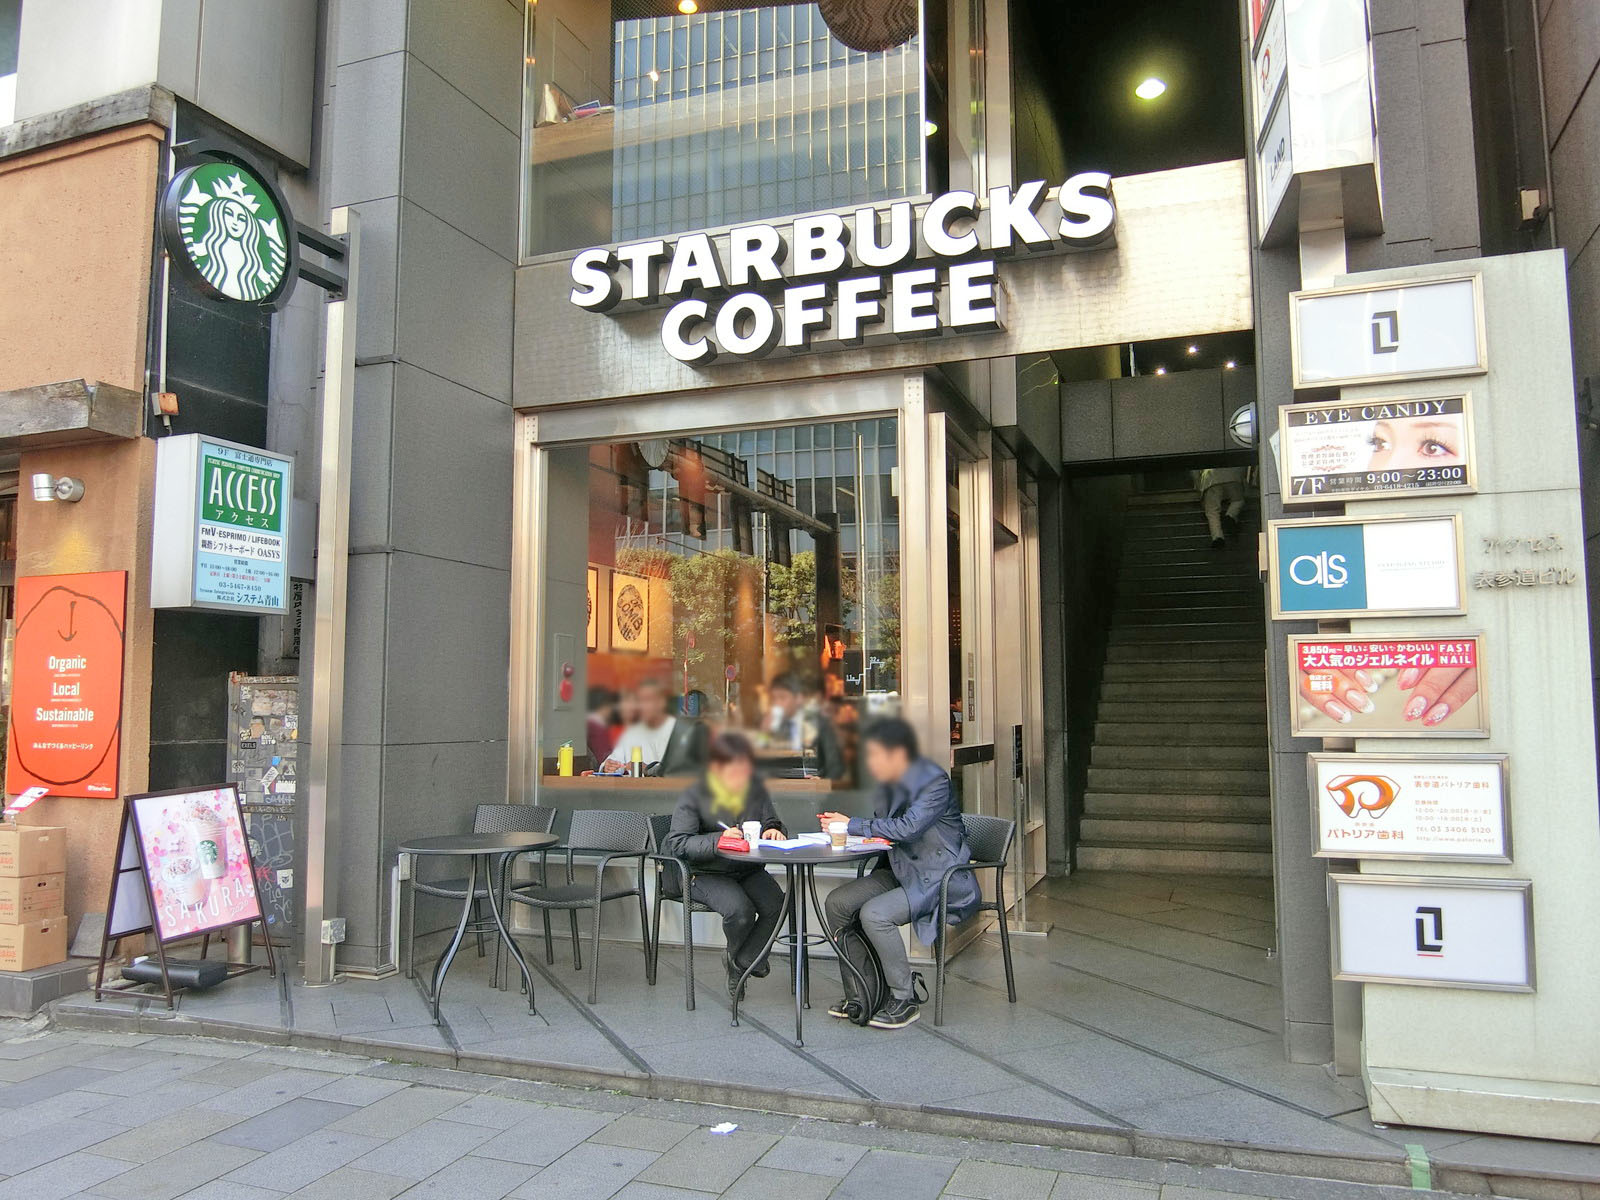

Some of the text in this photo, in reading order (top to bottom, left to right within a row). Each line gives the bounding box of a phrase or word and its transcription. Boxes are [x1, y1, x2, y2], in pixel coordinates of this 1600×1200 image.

[570, 171, 1116, 309] STARBUCKS
[661, 259, 1000, 364] COFFEE
[1305, 400, 1446, 425] EYE CANDY
[209, 466, 276, 516] ACCESS
[1293, 476, 1326, 496] 7F
[216, 509, 269, 529] アクセス
[251, 536, 281, 547] LIFEBOOK
[1480, 533, 1564, 554] アクセス
[257, 547, 281, 559] OASYS
[1474, 567, 1577, 589] 表参道ビル
[236, 592, 279, 607] システム青山
[1439, 643, 1471, 653] FAST
[48, 655, 87, 673] Organic
[1303, 654, 1435, 668] 大人気のジェルネイル
[1439, 655, 1472, 665] NAIL
[53, 681, 80, 696] Local
[36, 706, 94, 722] Sustainable
[165, 877, 246, 927] SAKURA
